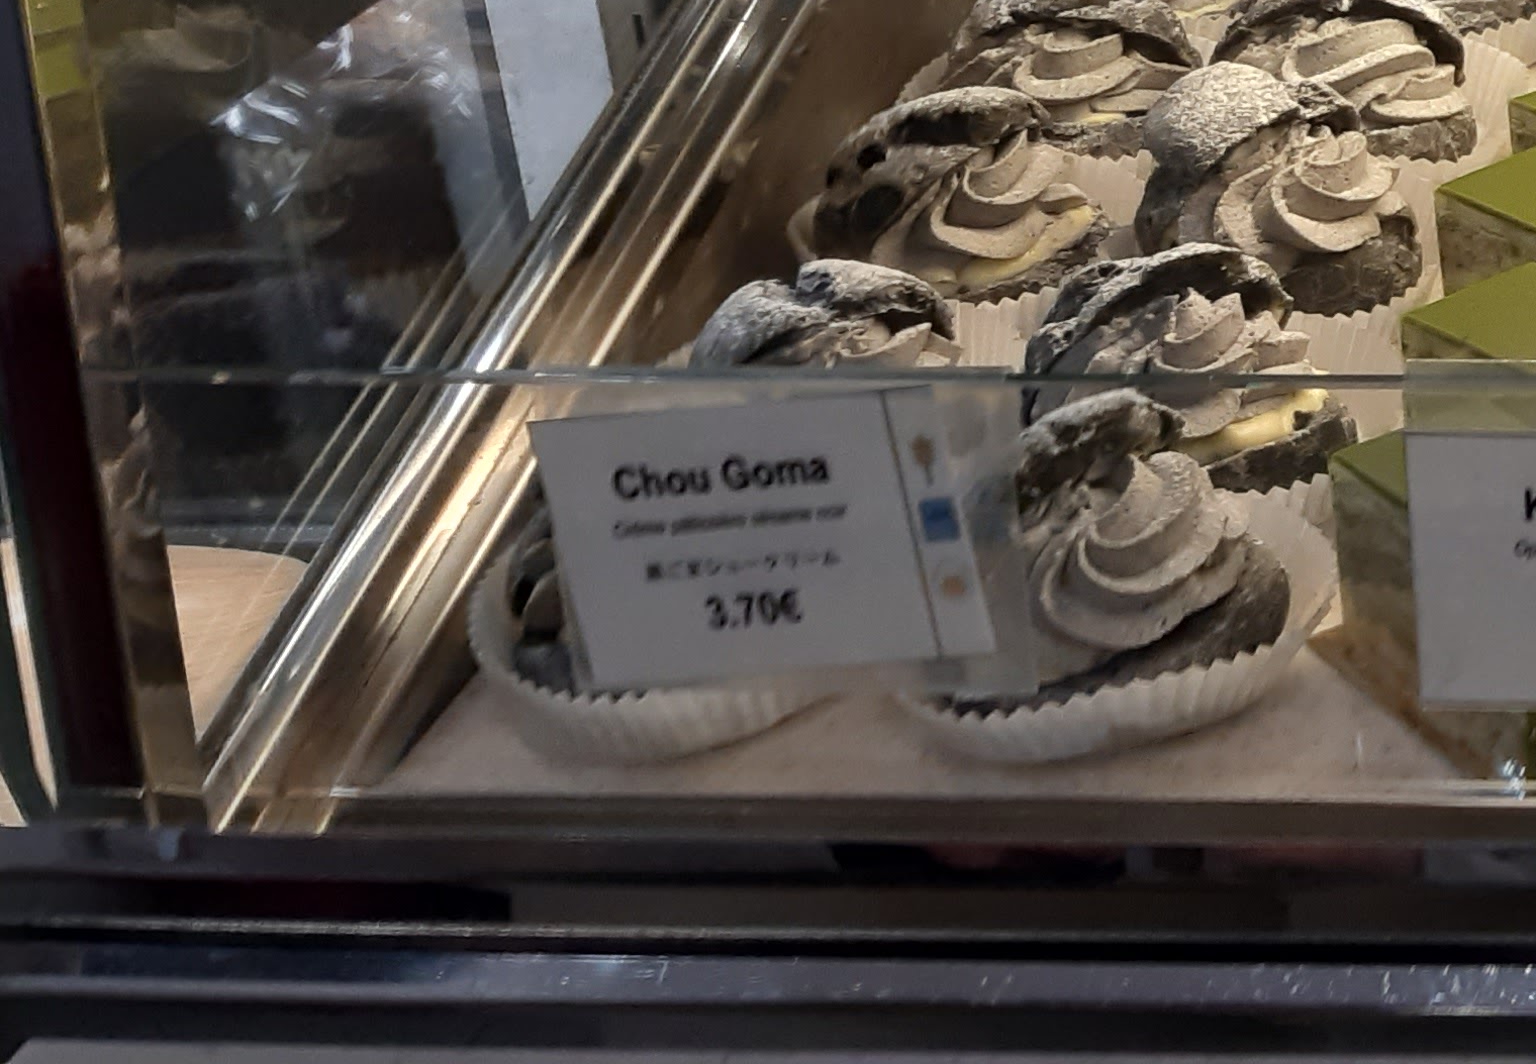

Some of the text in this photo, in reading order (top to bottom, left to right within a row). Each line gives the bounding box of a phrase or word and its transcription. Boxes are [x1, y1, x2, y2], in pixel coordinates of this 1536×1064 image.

[610, 454, 831, 500] Chou Goma
[704, 590, 804, 630] 3.70€
